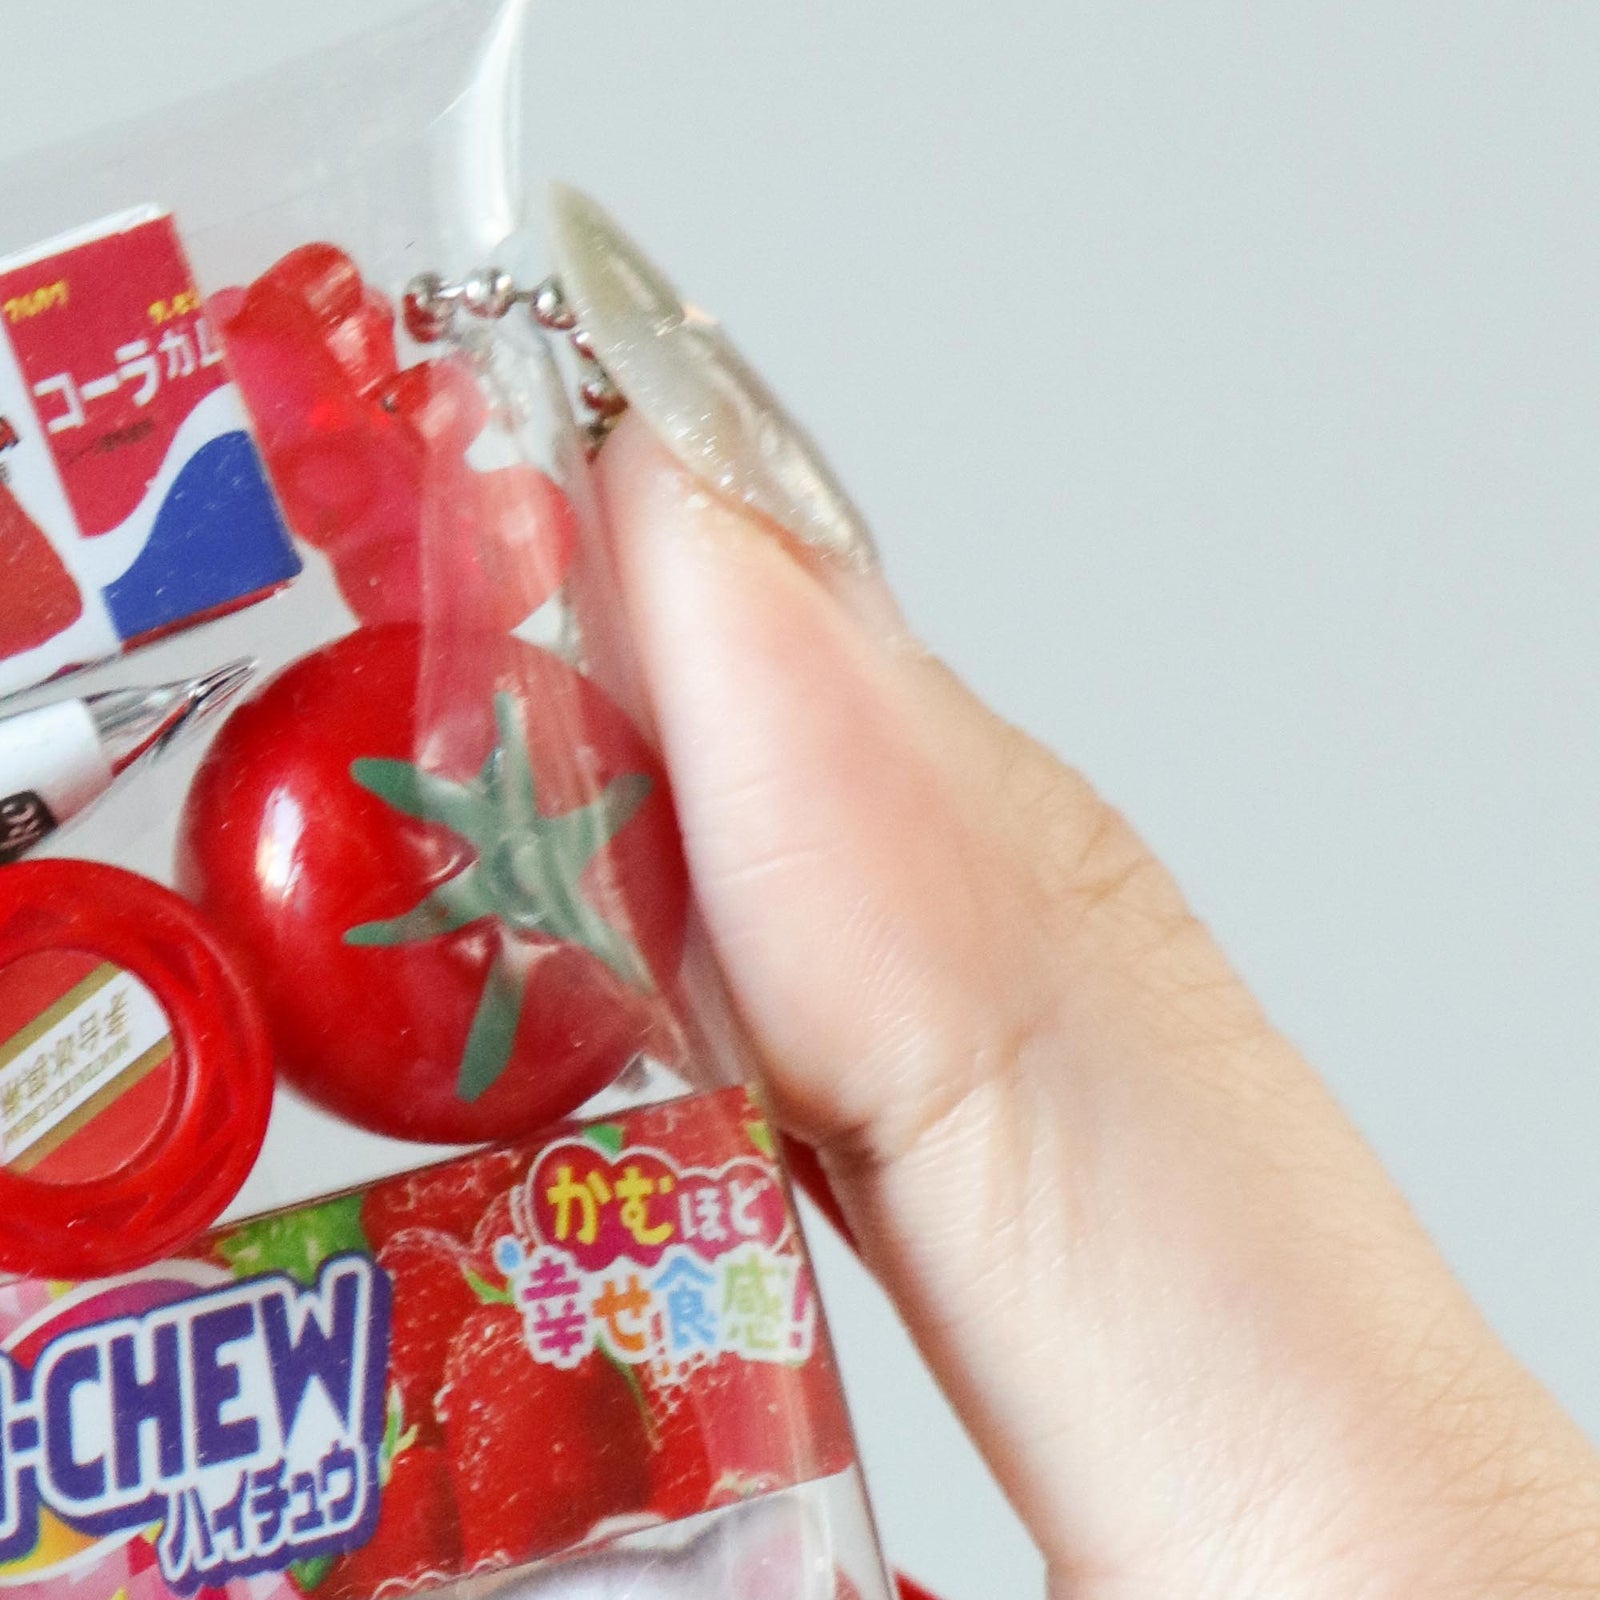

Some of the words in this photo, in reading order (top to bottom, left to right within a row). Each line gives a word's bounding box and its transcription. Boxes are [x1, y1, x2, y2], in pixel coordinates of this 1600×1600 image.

[34, 317, 224, 434] コーラガム
[545, 1165, 771, 1246] かむほど
[166, 1443, 360, 1580] ハイチュウ
